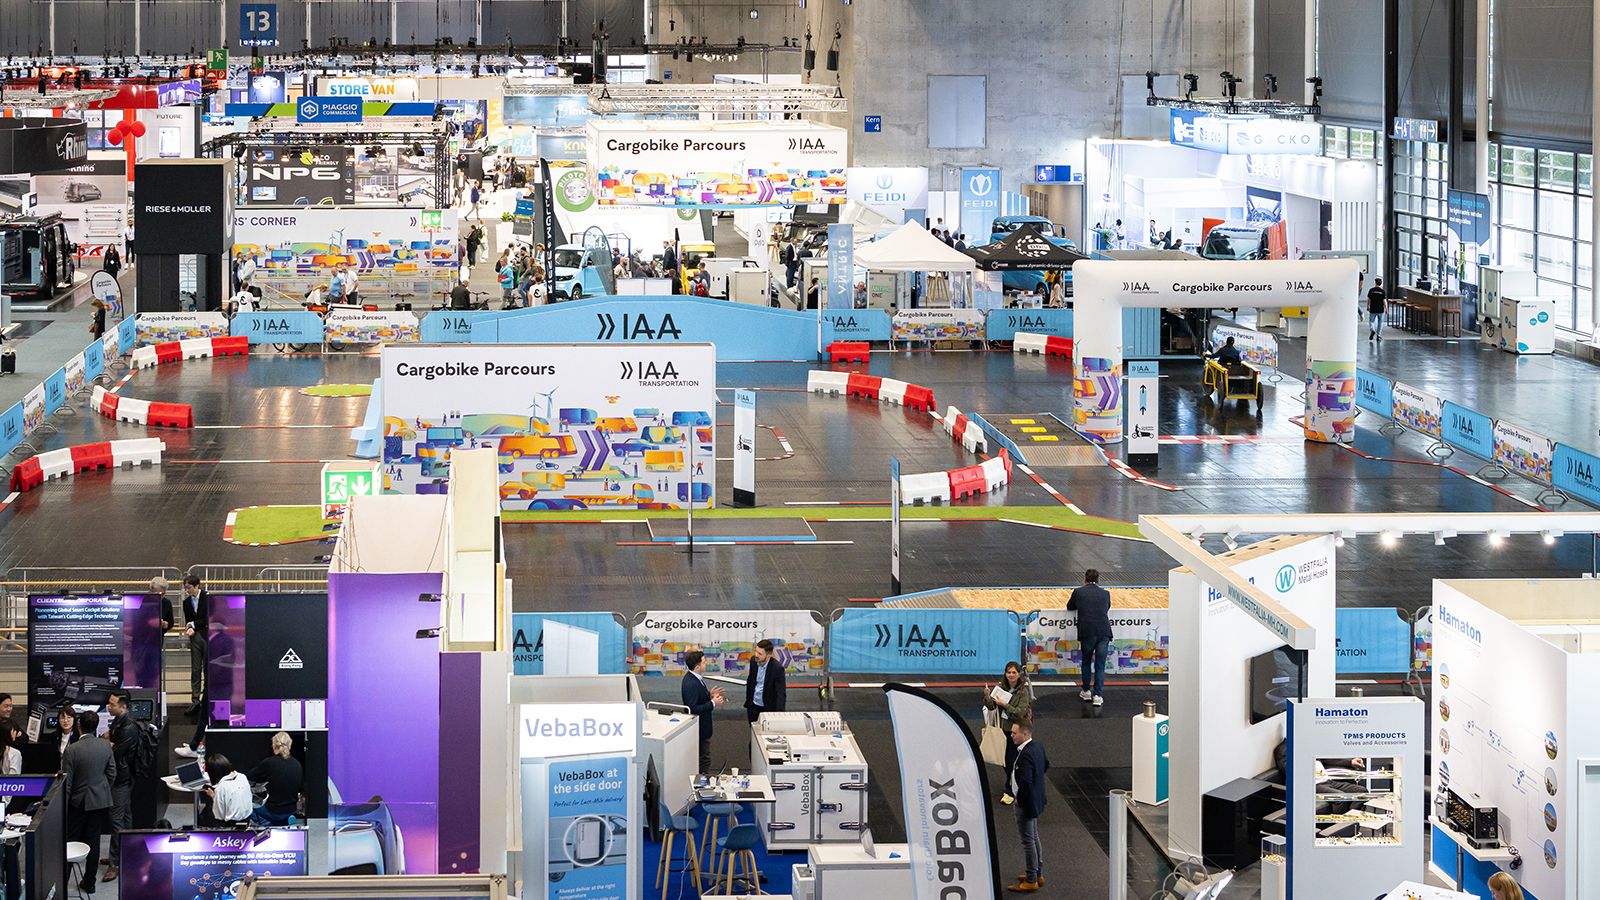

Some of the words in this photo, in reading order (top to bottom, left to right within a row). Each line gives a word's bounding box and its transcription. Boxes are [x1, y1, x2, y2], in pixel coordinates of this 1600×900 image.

[246, 11, 272, 32] 13
[330, 84, 369, 95] STORE
[371, 84, 395, 95] VAN
[800, 138, 825, 150] IAA
[1254, 134, 1311, 144] GCKO
[606, 138, 678, 155] Cargobike
[684, 138, 746, 150] Parcours
[252, 167, 341, 181] NP6
[864, 193, 906, 201] FEIDI
[250, 216, 297, 226] CORNER
[1131, 282, 1150, 291] IAA
[1172, 282, 1224, 294] Cargobike
[1228, 282, 1272, 292] Parcours
[1294, 281, 1314, 290] IAA
[264, 319, 290, 330] IAA
[454, 318, 472, 329] IA
[624, 314, 682, 339] IAA
[1020, 316, 1046, 327] IAA
[396, 362, 479, 380] Cargobike
[484, 362, 556, 376] Parcours
[639, 361, 679, 380] IAA
[1362, 378, 1376, 397] IAA
[1458, 415, 1474, 436] IAA
[1497, 424, 1515, 437] Cargobike
[1515, 431, 1532, 443] Parcours
[1574, 460, 1593, 482] IAA
[1298, 557, 1328, 574] WESTFALIA
[1298, 573, 1312, 584] Metal
[1314, 569, 1328, 580] Hoses
[645, 618, 704, 632] Cargobike
[707, 619, 758, 629] Parcours
[1039, 617, 1078, 629] Cargob
[1109, 618, 1151, 626] arcours
[1440, 605, 1481, 643] Hamaton
[898, 624, 951, 648] IAA
[1315, 708, 1368, 716] Hamaton
[526, 718, 624, 737] VebaBox
[559, 770, 604, 781] VebaBox
[607, 768, 618, 778] at
[553, 783, 571, 794] the
[574, 781, 596, 792] side
[598, 780, 622, 790] door
[801, 774, 810, 816] VebaBox
[212, 836, 247, 849] Askey
